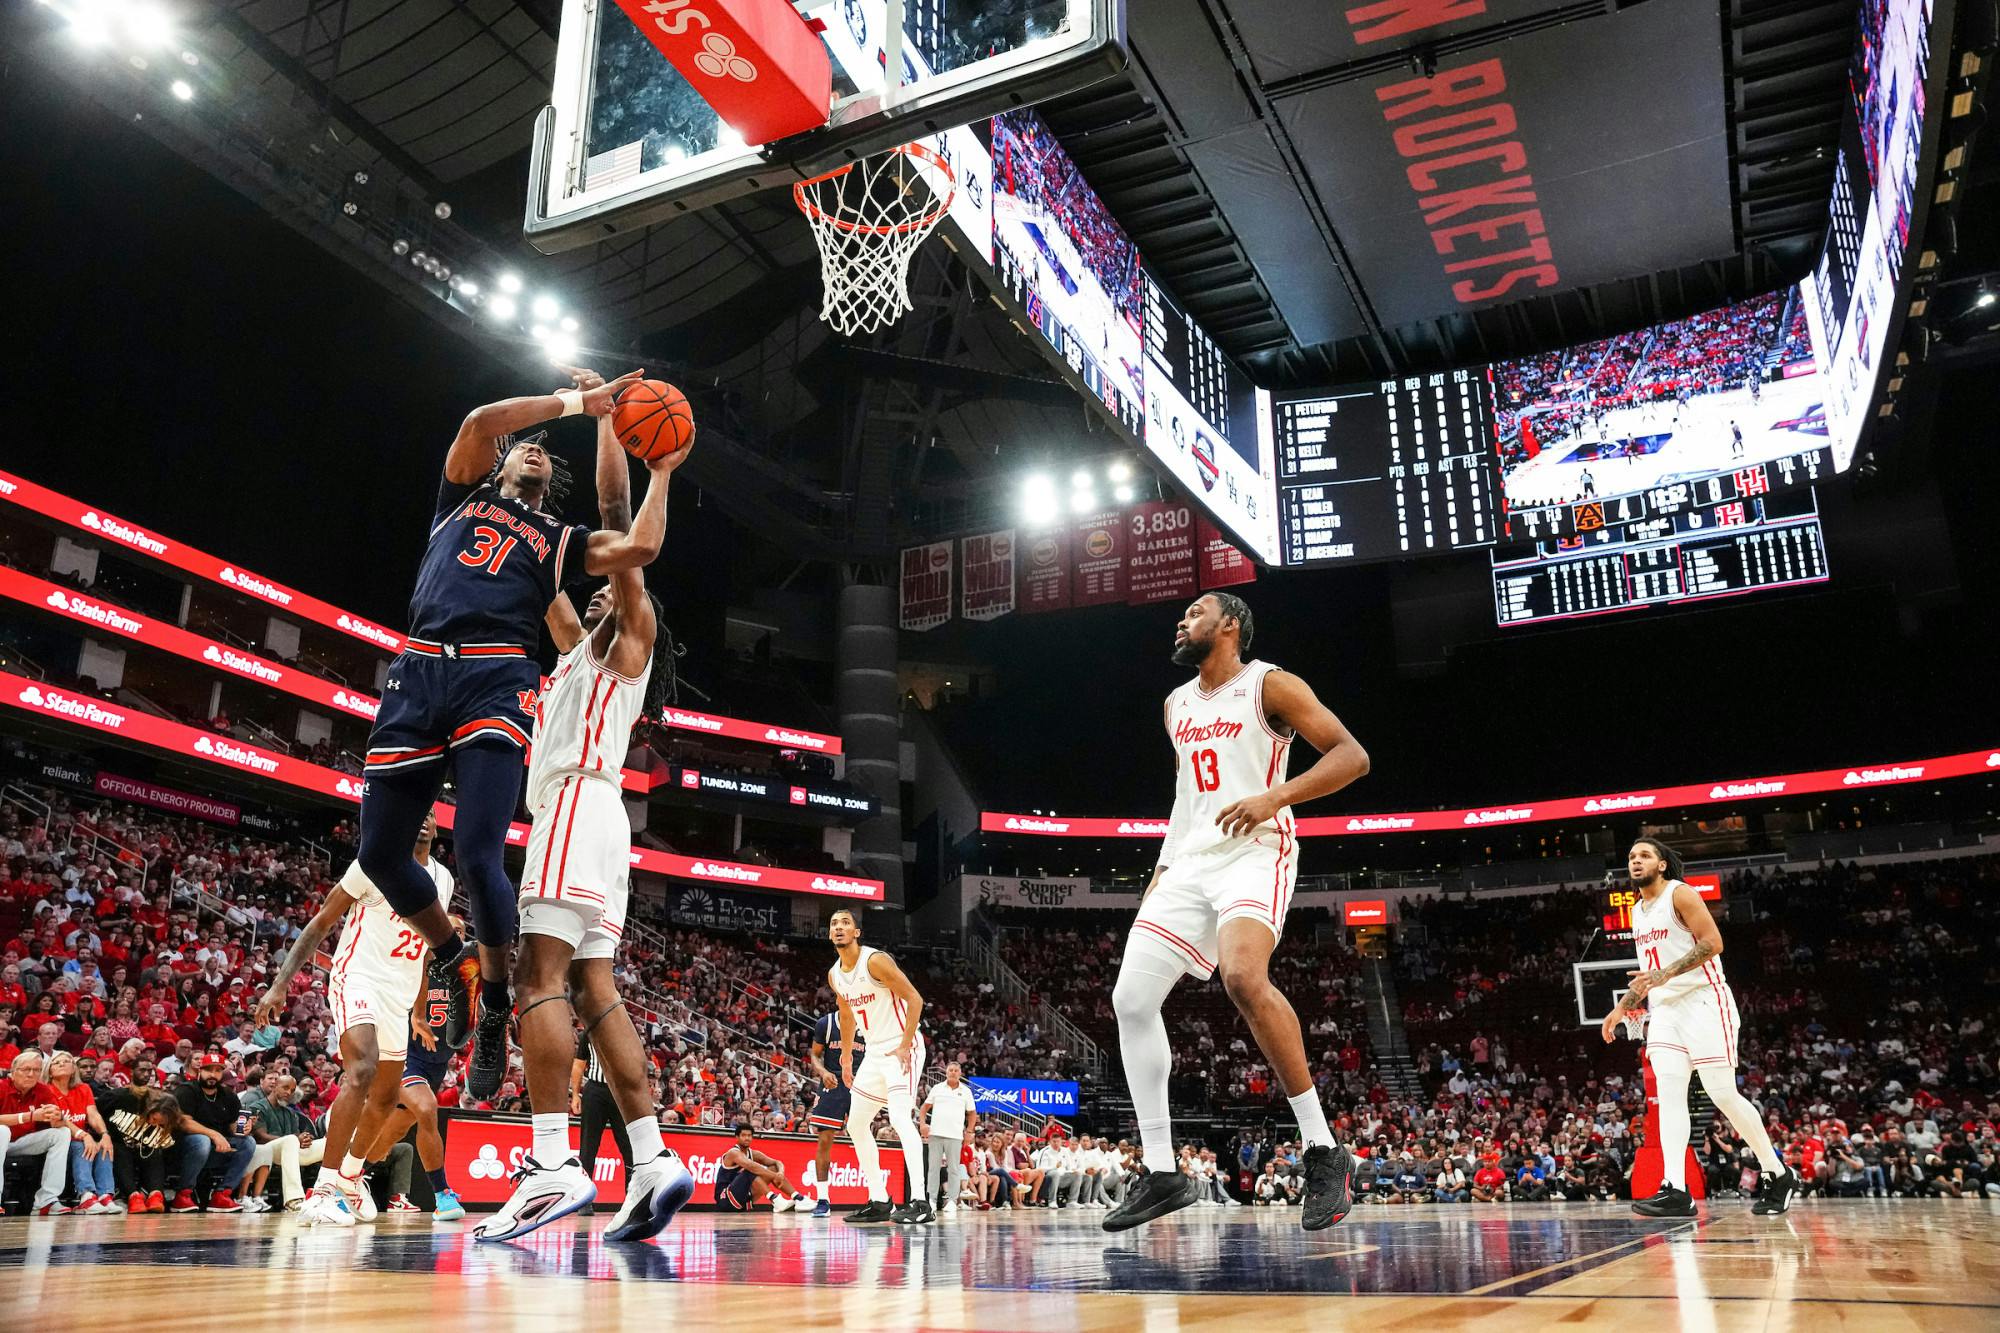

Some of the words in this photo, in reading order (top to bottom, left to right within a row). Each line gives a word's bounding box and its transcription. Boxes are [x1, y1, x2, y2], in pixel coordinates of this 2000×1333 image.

[1375, 57, 1559, 303] ROCKETS
[1381, 381, 1397, 394] PTS
[1404, 377, 1421, 390] REB
[1429, 373, 1444, 387] AST
[1453, 370, 1468, 383] FLS
[1389, 465, 1405, 478] PTS
[1413, 462, 1429, 475] REB
[1438, 459, 1453, 472] AST
[1463, 455, 1478, 468] FLS
[1618, 497, 1631, 521] 4
[456, 502, 551, 564] AUBURN
[1132, 507, 1190, 538] 3,830
[457, 526, 518, 576] 31
[1137, 536, 1189, 551] HAKEEM
[1131, 549, 1193, 566] OLAJUWON
[1175, 717, 1243, 746] Houston
[43, 765, 80, 783] reliant
[1191, 748, 1220, 793] 13
[701, 776, 738, 791] TUNDRA
[740, 783, 766, 796] ZONE
[100, 779, 148, 799] OFFICIAL
[150, 790, 190, 810] ENERGY
[190, 800, 236, 821] PROVIDER
[808, 792, 843, 807] TUNDRA
[845, 798, 869, 811] ZONE
[241, 814, 271, 831] reliant
[1019, 880, 1077, 897] Supper
[1028, 891, 1066, 906] Club
[1609, 891, 1636, 907] 13:5
[718, 898, 779, 929] Frost
[390, 929, 425, 961] 23
[1645, 946, 1661, 970] 21
[428, 1003, 449, 1027] 5
[857, 1009, 869, 1031] 7
[1029, 1090, 1074, 1105] ULTRA
